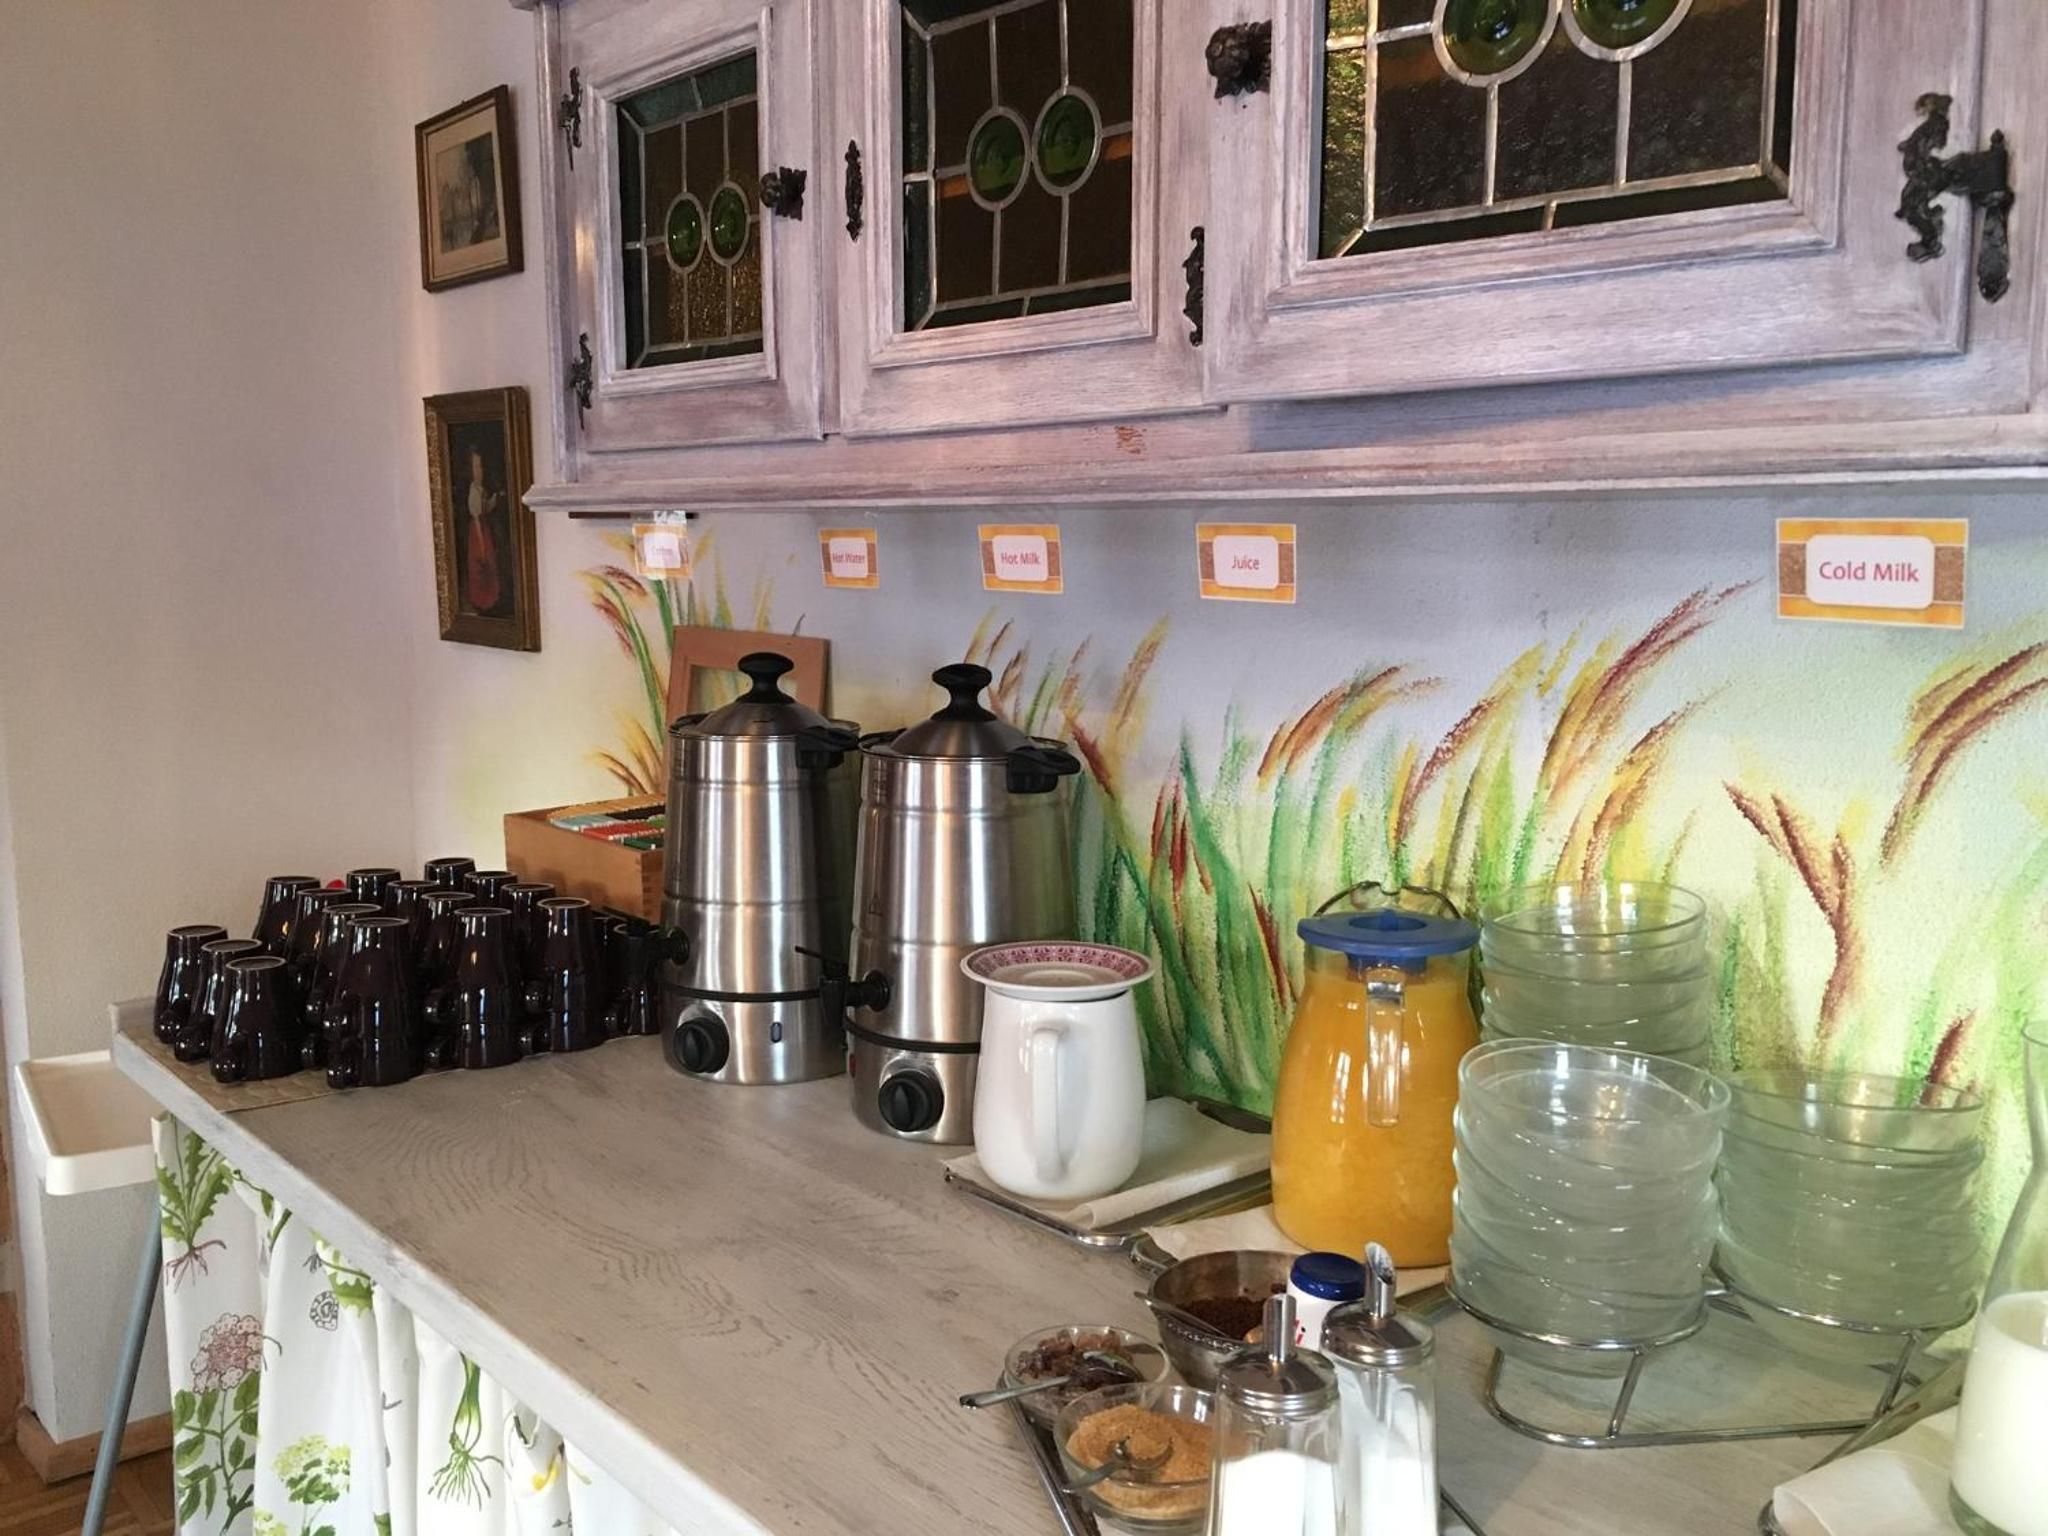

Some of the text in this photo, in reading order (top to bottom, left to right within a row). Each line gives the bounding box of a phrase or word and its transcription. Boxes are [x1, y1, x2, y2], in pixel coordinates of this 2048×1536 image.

[1001, 552, 1040, 565] Hot Milk
[1231, 554, 1260, 570] Juice
[1819, 561, 1919, 582] Cold Milk
